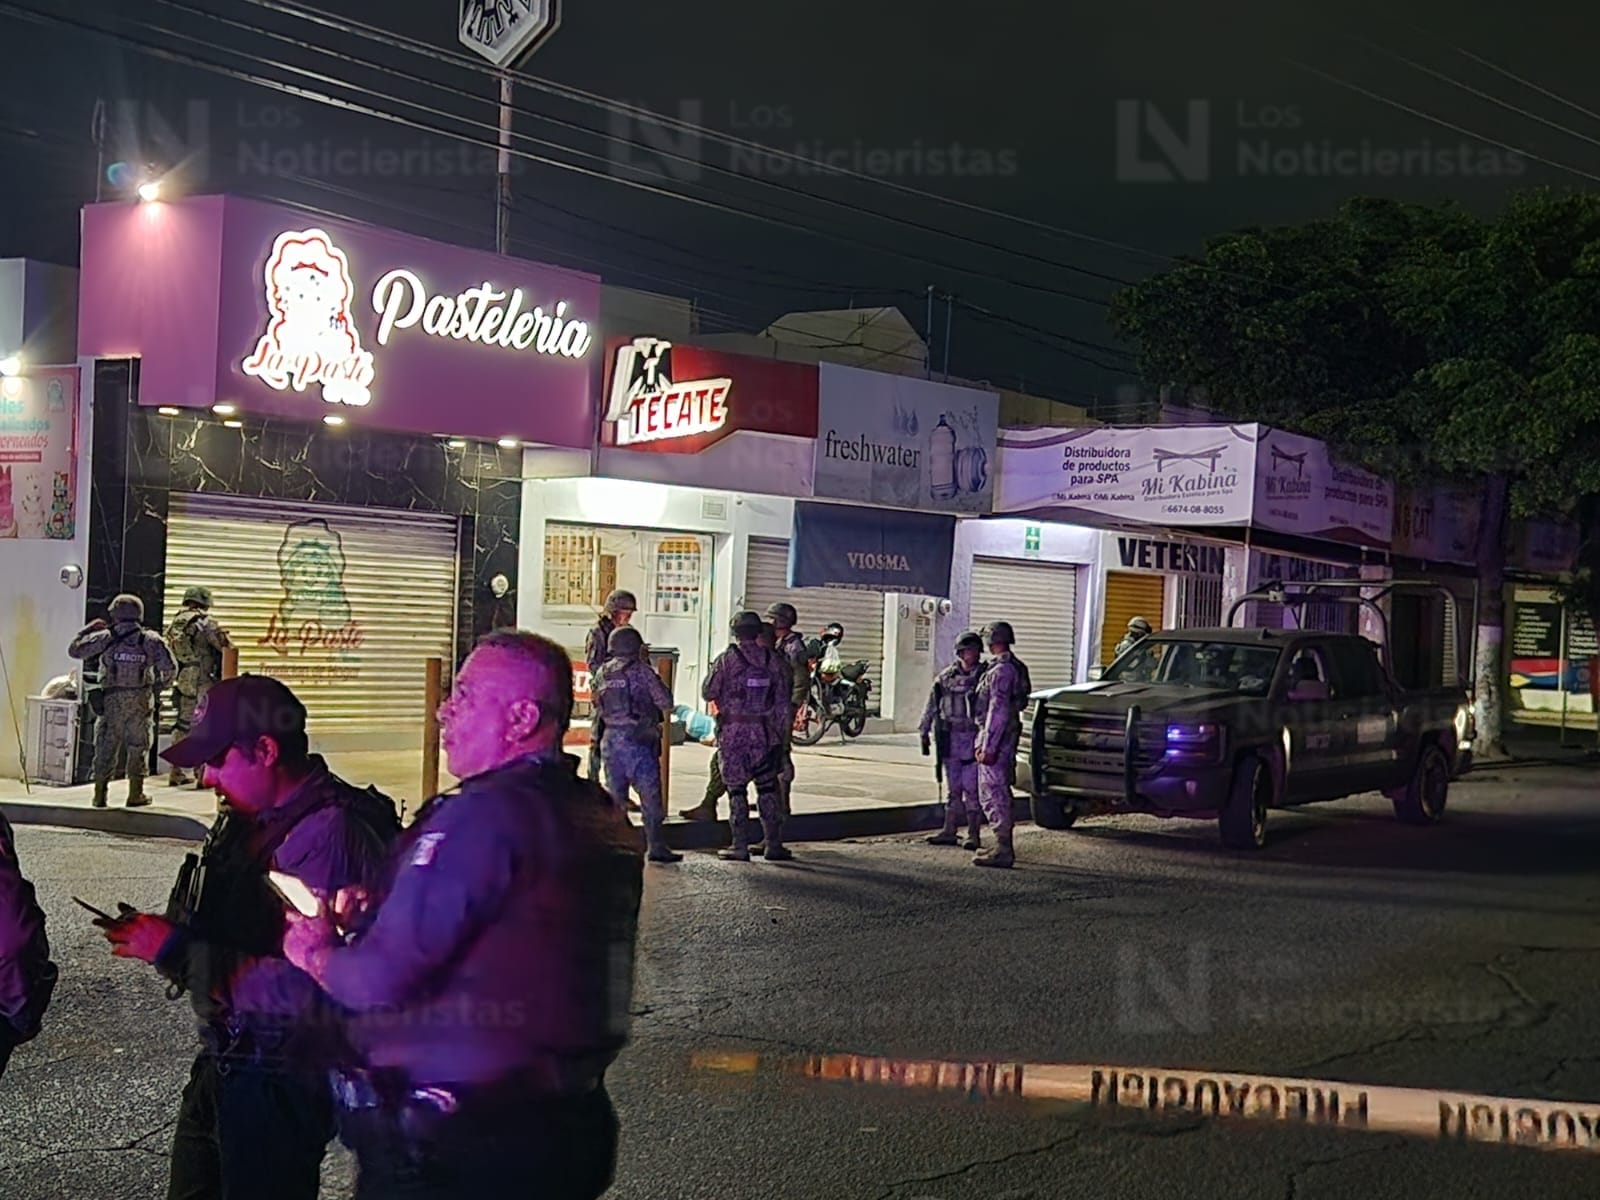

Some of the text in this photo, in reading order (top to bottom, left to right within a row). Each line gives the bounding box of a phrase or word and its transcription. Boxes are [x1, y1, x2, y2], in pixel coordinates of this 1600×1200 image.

[629, 386, 726, 435] TECATE
[824, 429, 921, 468] freshwater
[1064, 446, 1132, 459] Distribuidora
[1062, 460, 1131, 473] de productos
[1070, 473, 1119, 486] para SPA
[1141, 471, 1239, 496] Mi Kabina
[847, 552, 910, 571] VIOSMA
